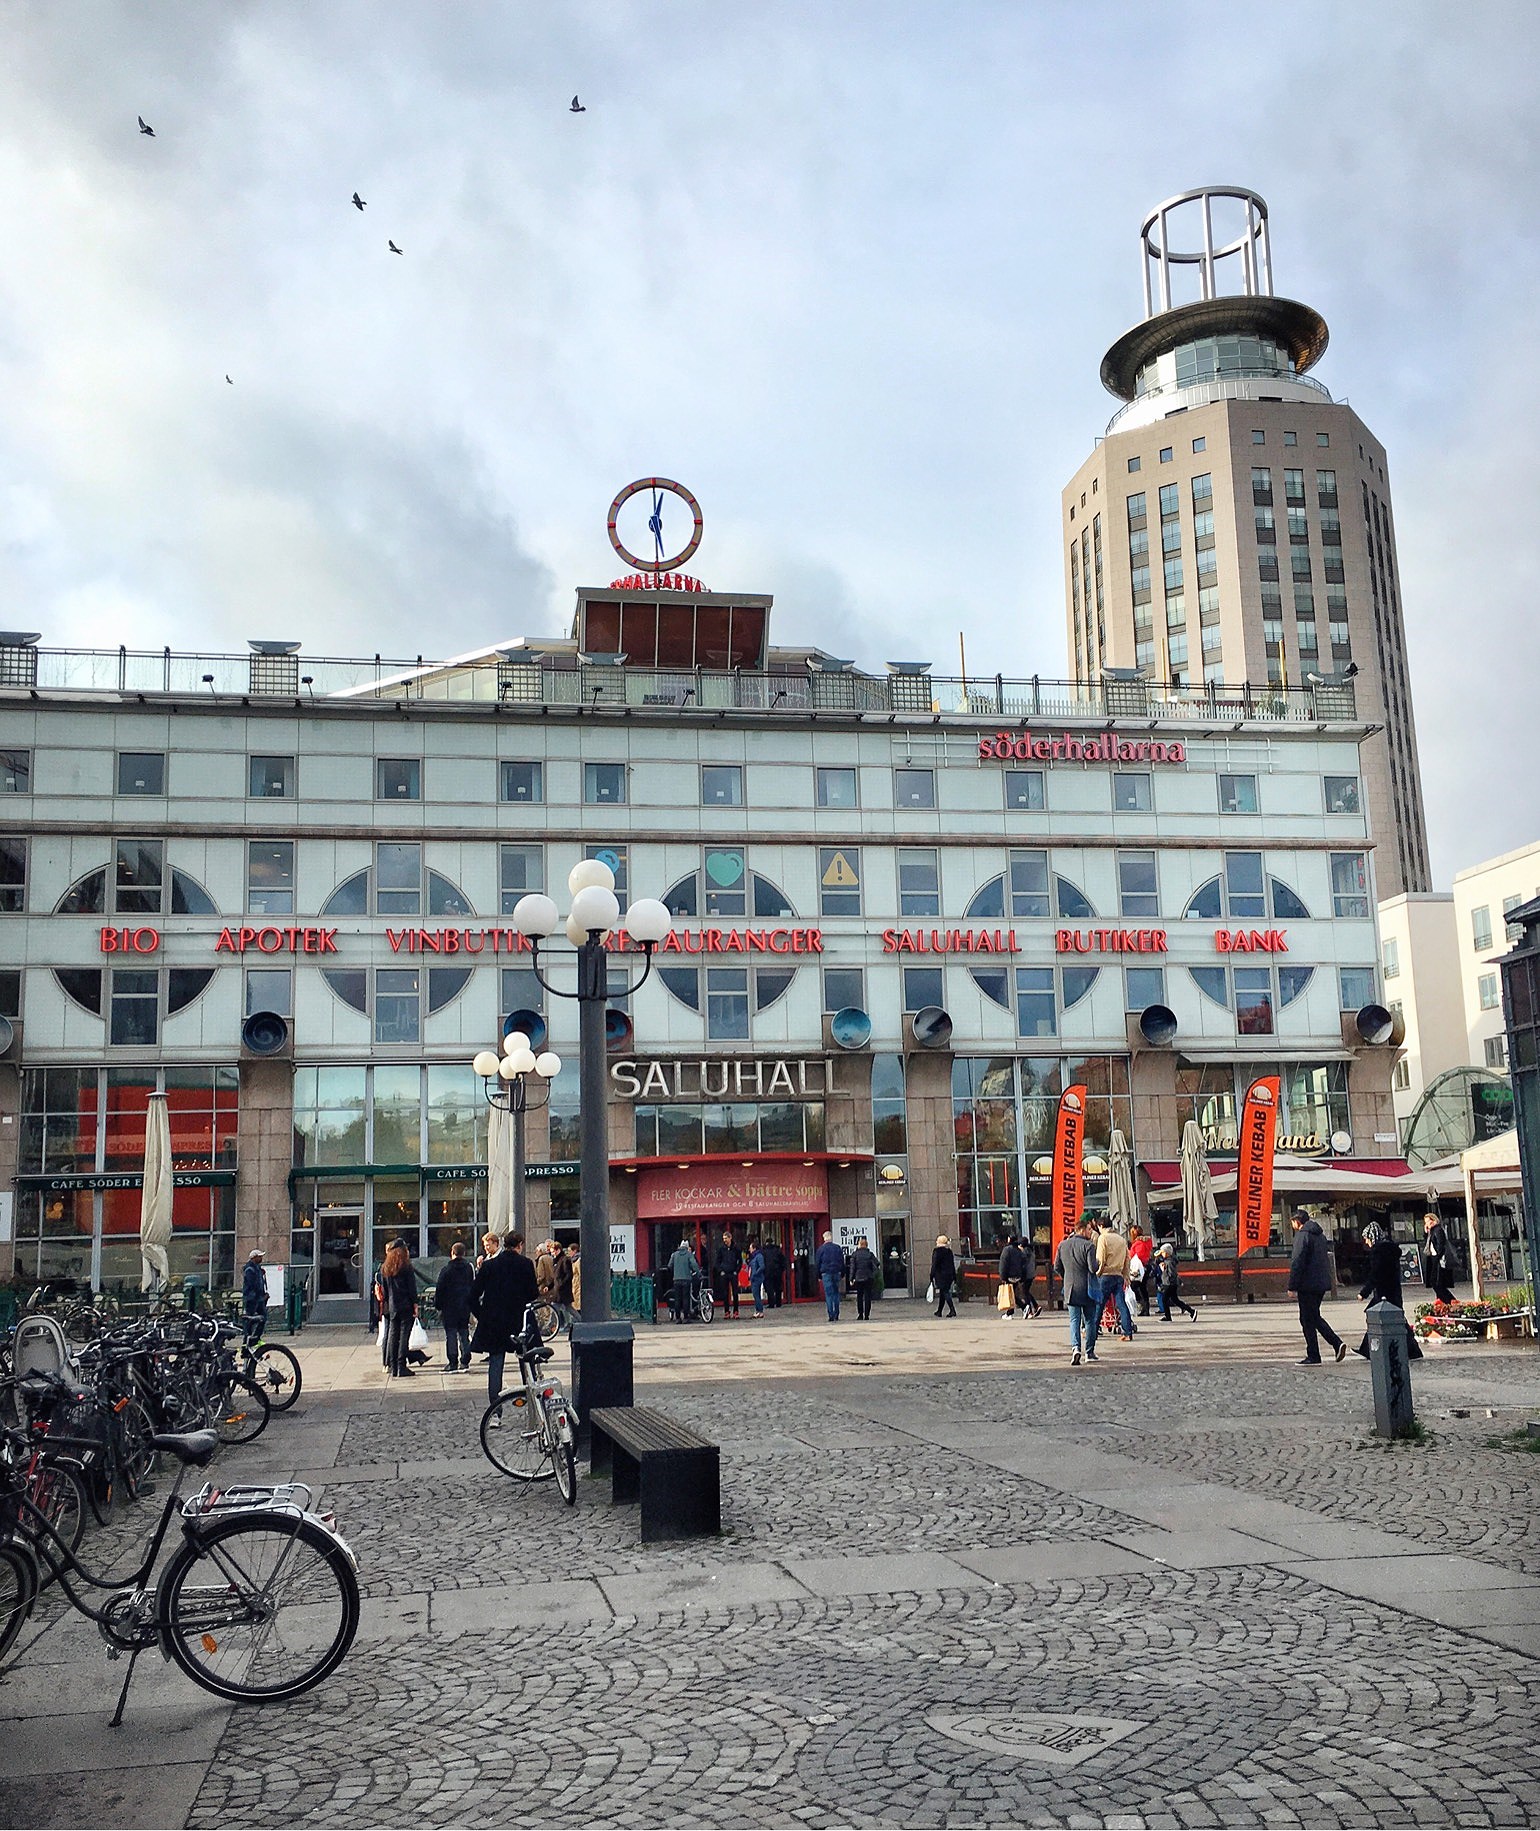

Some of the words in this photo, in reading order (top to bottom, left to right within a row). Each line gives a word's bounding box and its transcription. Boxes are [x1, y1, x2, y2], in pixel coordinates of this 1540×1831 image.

[979, 731, 1186, 762] söderhallarna
[100, 927, 159, 953] BIO
[214, 927, 338, 952] APOTEK
[603, 928, 824, 953] REAURANGER
[882, 928, 1022, 953] SALUHALL
[1056, 929, 1168, 953] BUTIKER
[1215, 929, 1289, 952] BANK
[610, 1059, 851, 1098] SALUHALL
[1064, 1118, 1077, 1169] KEBAB
[1251, 1110, 1267, 1166] KEBAB
[51, 1179, 83, 1189] CAFE
[437, 1169, 467, 1178] CAFE
[651, 1189, 671, 1201] FLER
[675, 1187, 722, 1200] KOCKAR
[727, 1184, 741, 1198] &
[746, 1182, 793, 1198] bättre
[1063, 1172, 1078, 1240] ERLINER
[1246, 1166, 1264, 1240] BERLINER
